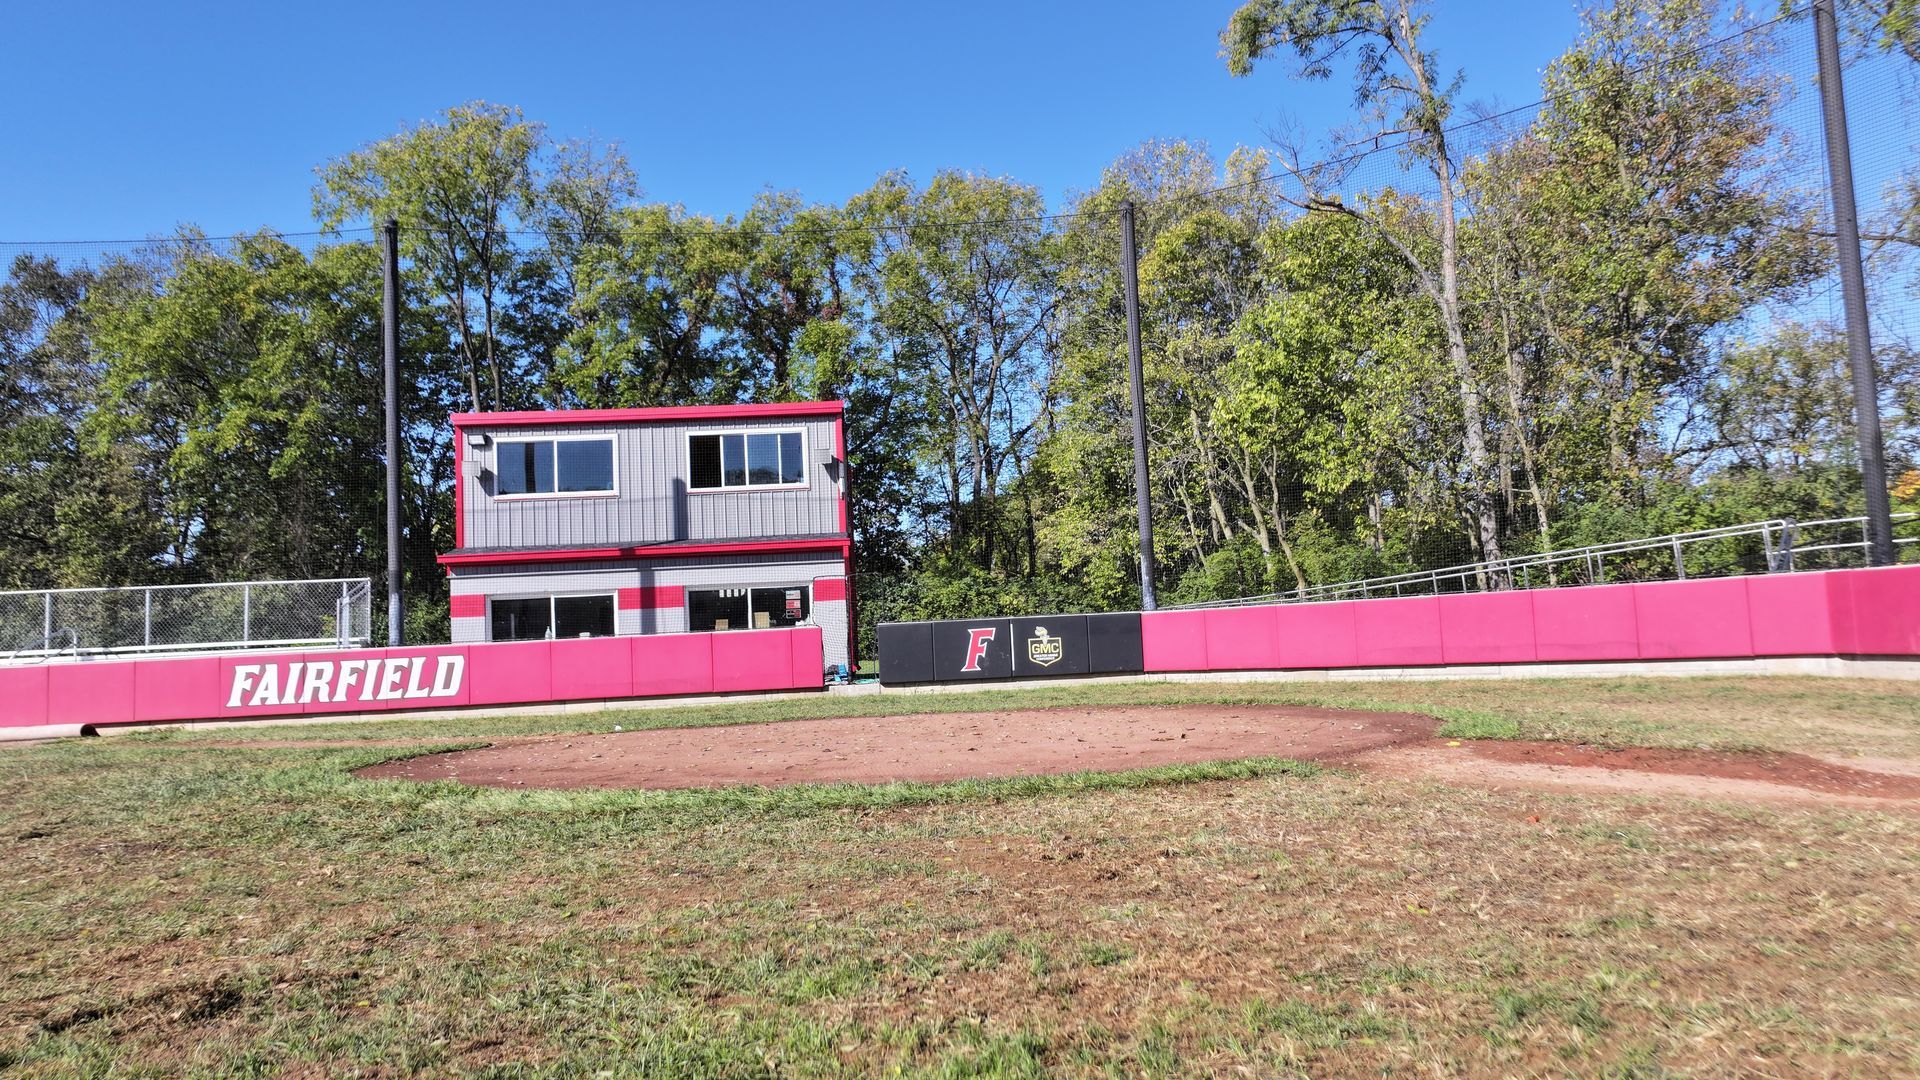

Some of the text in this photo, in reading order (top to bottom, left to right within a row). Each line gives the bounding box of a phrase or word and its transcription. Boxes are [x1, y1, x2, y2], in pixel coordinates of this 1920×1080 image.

[960, 627, 996, 672] F
[1031, 643, 1060, 654] GMC
[225, 655, 465, 707] FAIRFIELD
